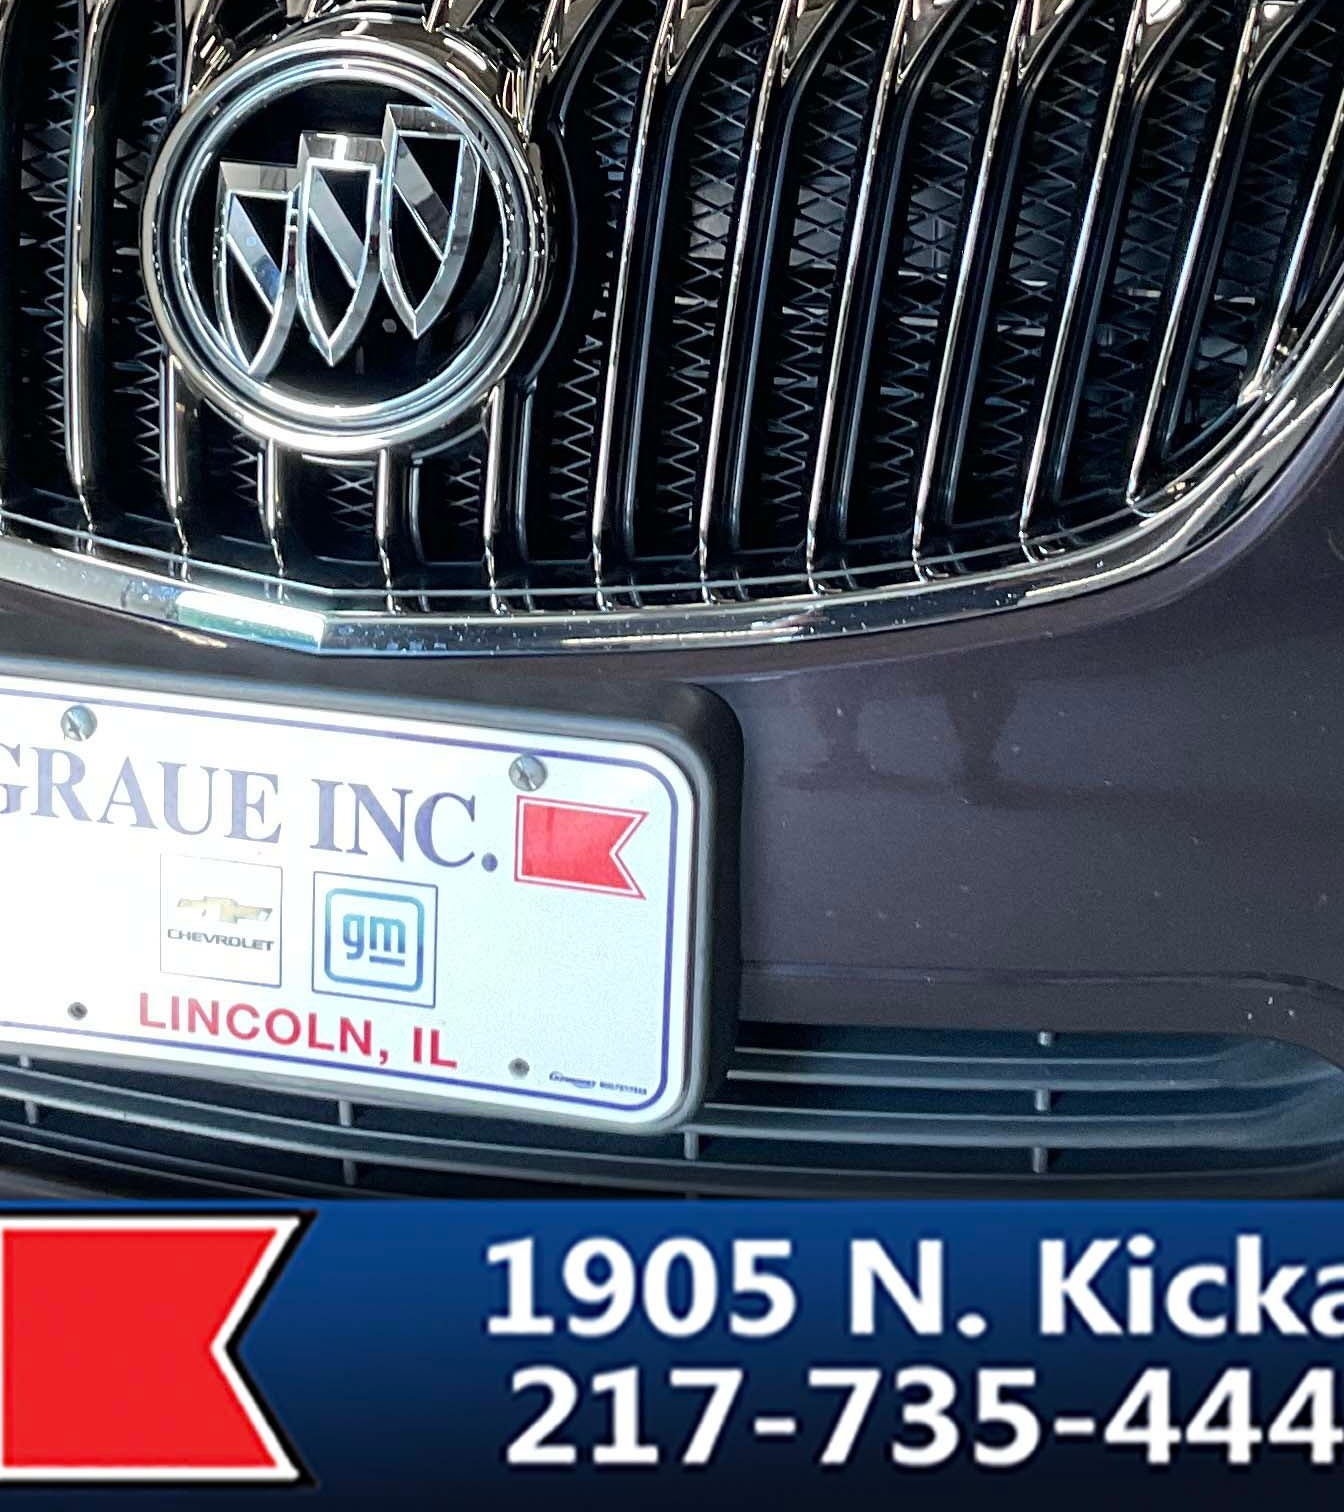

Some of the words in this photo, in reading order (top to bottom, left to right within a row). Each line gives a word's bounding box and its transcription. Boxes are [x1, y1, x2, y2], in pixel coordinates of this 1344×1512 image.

[311, 778, 499, 874] INC.
[167, 928, 275, 952] CHEVROLET
[342, 913, 406, 961] gm
[139, 992, 389, 1065] LINCOLN,
[412, 1025, 458, 1069] IL
